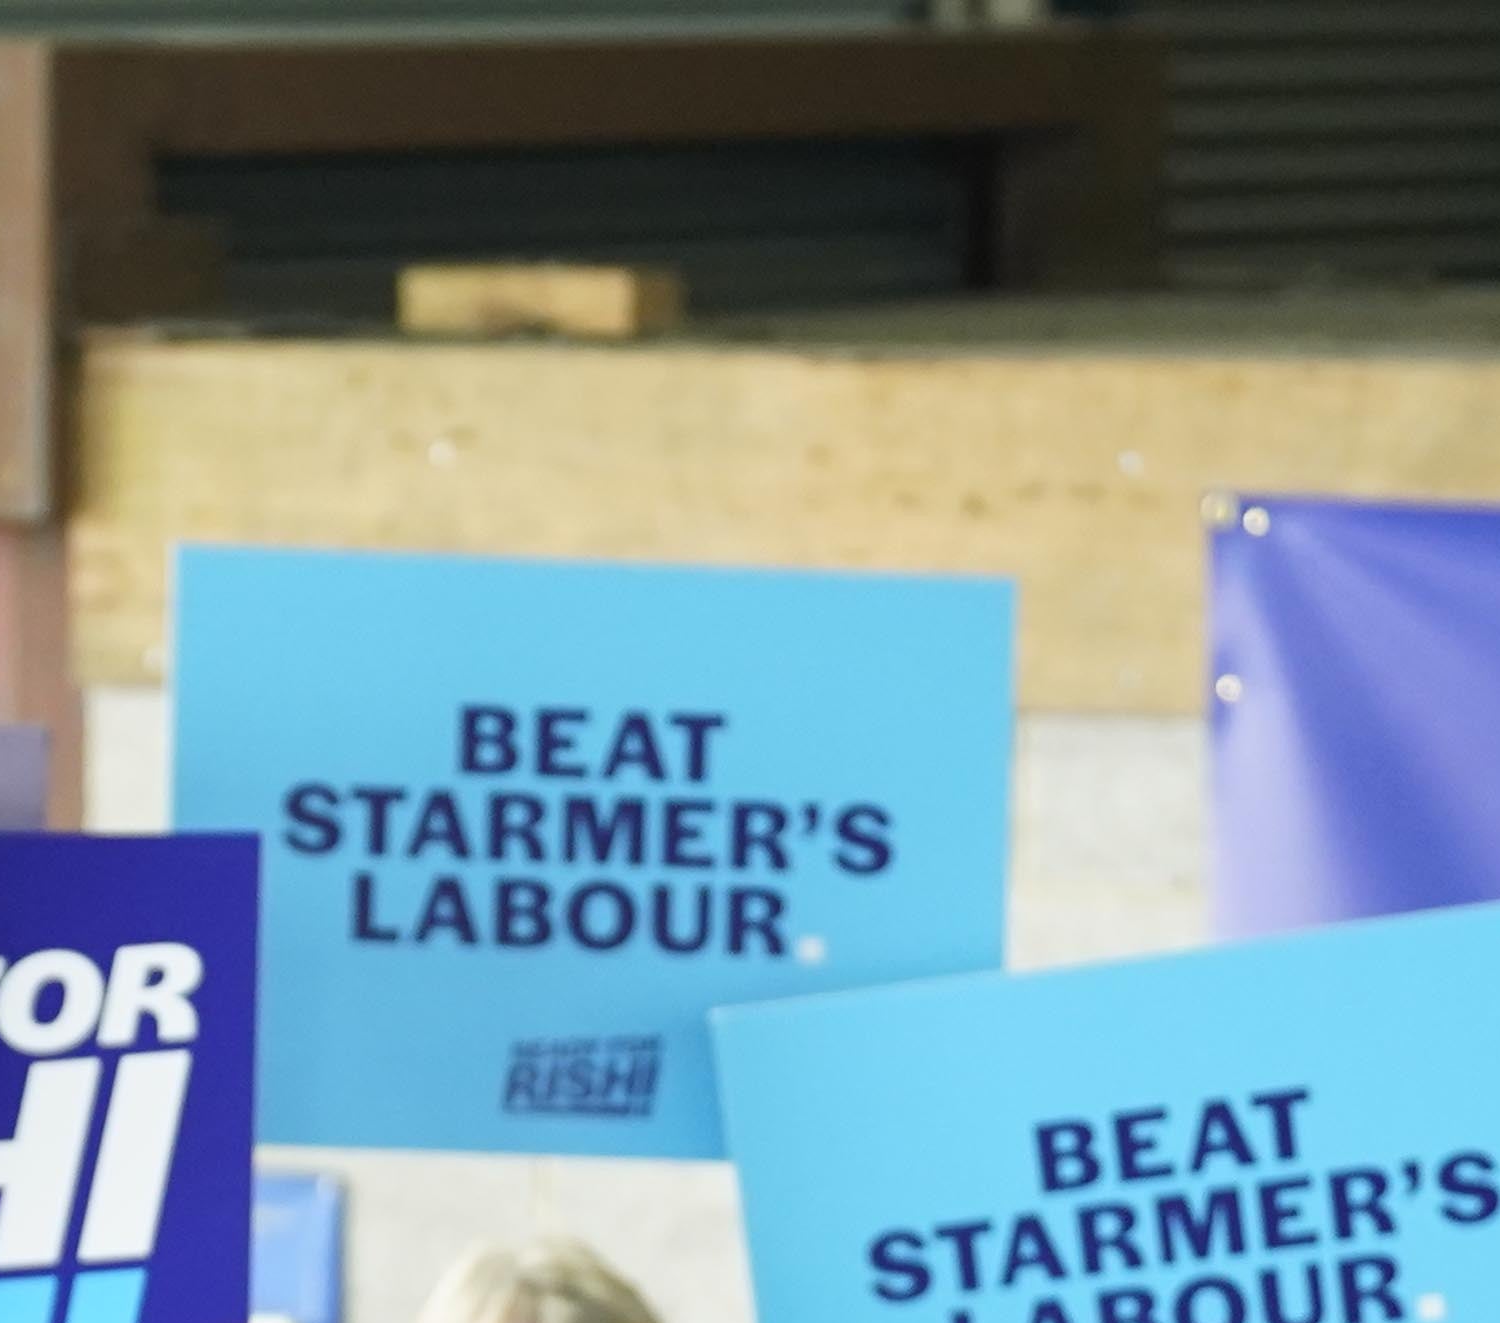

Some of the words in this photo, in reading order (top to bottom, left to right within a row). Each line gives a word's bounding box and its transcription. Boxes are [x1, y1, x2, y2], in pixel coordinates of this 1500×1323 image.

[459, 703, 727, 785] BEAT
[281, 782, 896, 877] STARMER'S
[1034, 1087, 1310, 1194] BEAT
